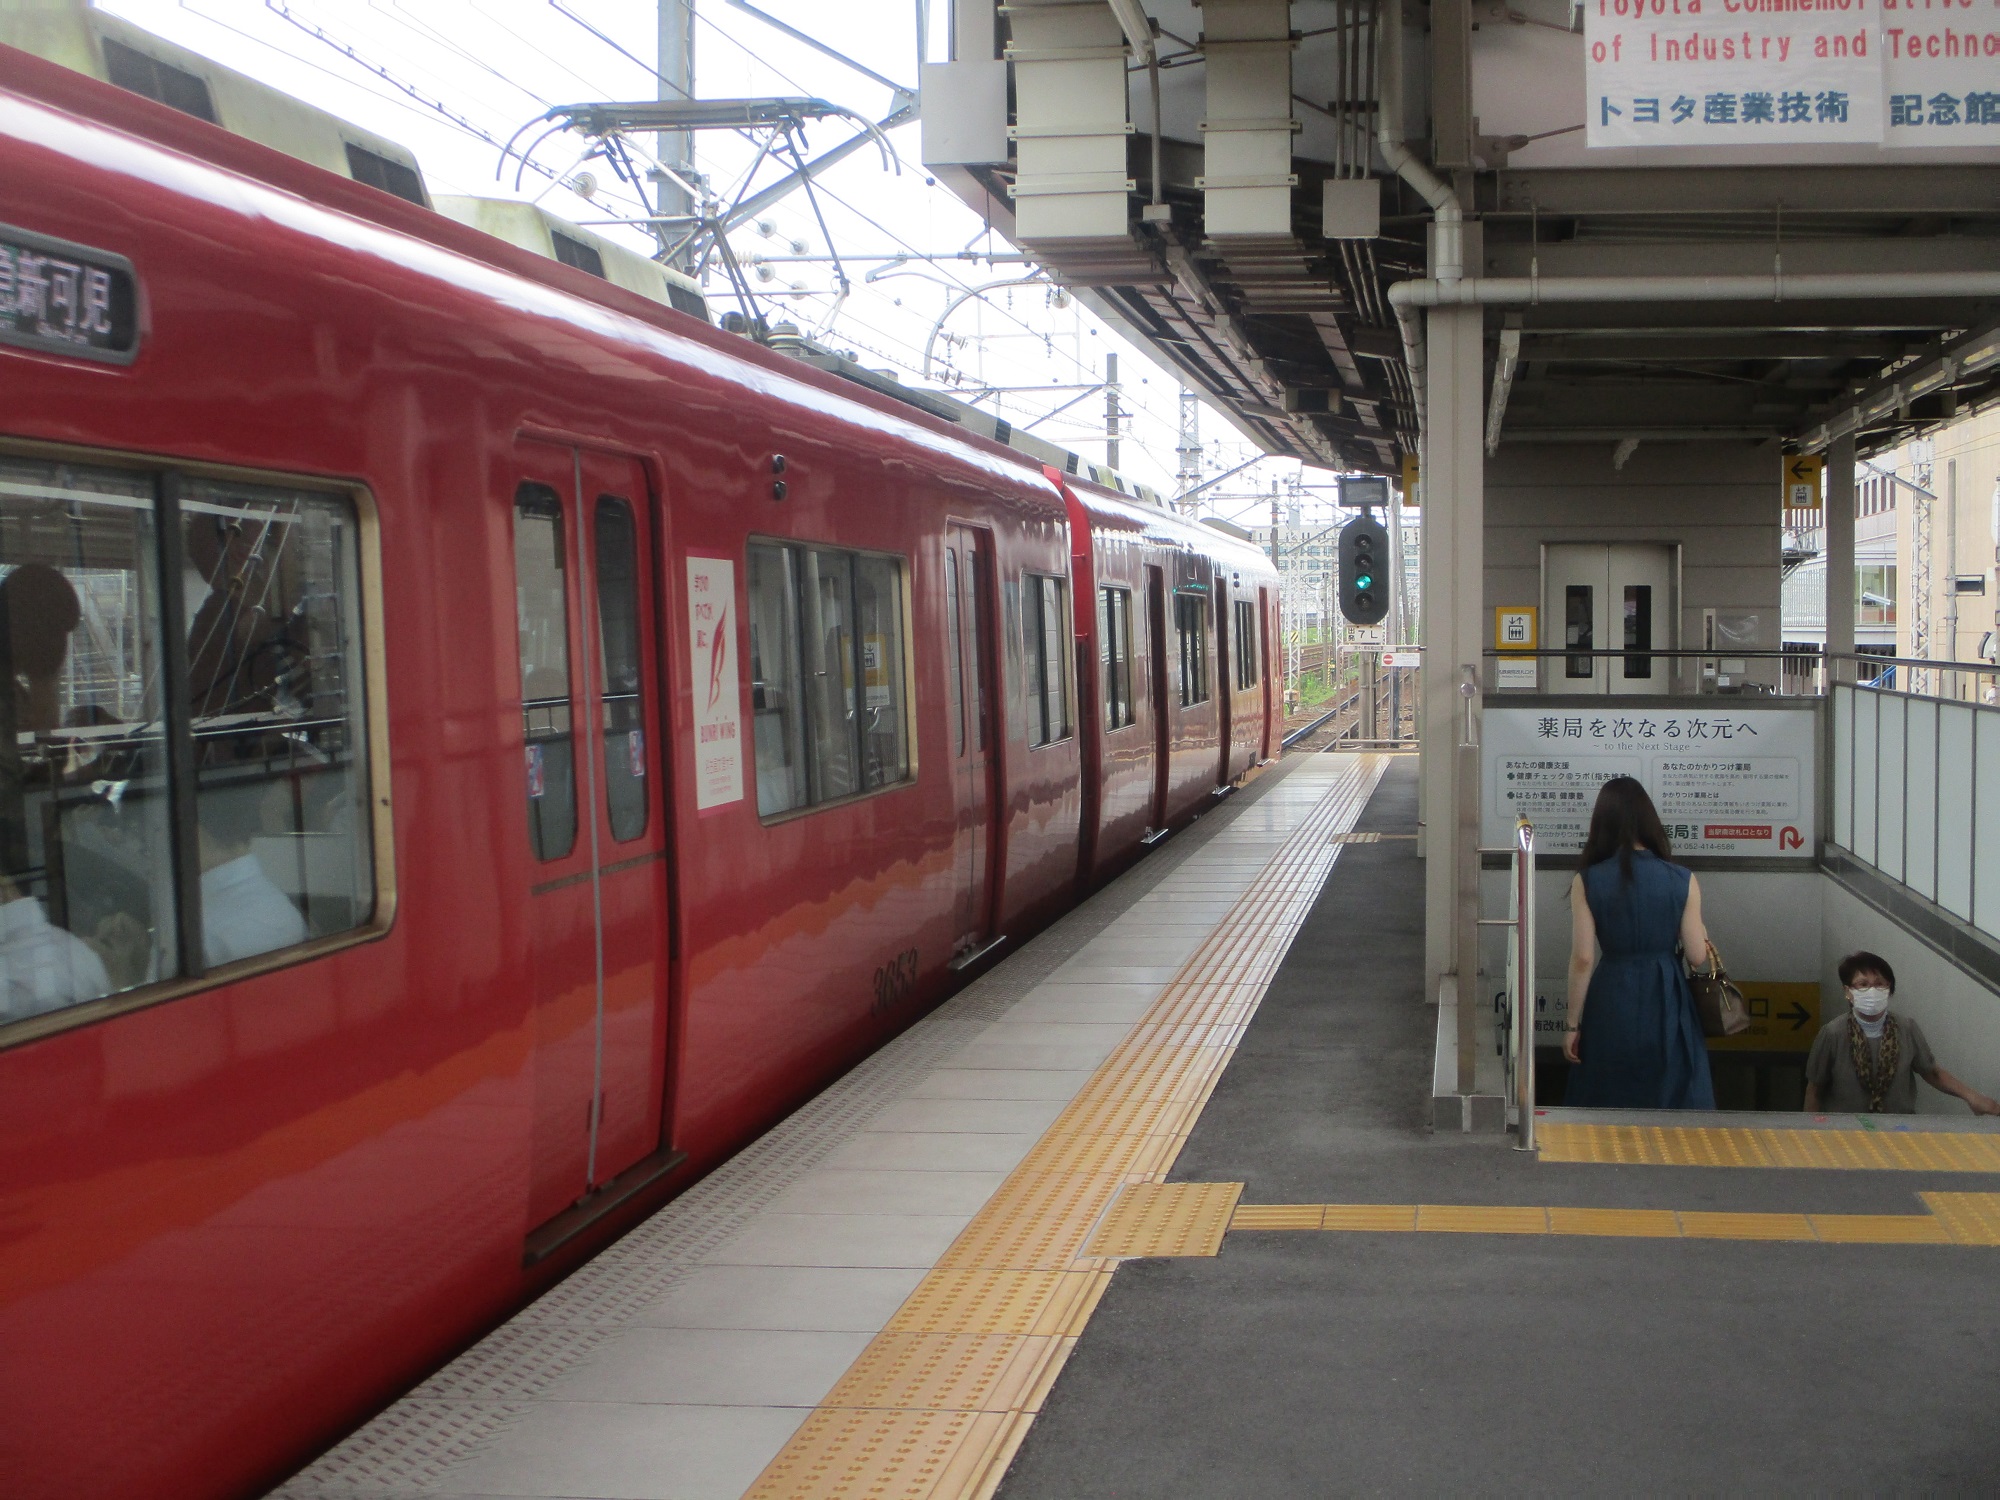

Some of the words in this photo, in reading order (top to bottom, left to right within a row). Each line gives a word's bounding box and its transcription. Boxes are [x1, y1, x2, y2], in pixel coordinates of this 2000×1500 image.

[1591, 34, 1622, 63] of
[1651, 32, 1791, 62] Industry
[1814, 29, 1867, 58] and
[1537, 717, 1758, 739] 薬局を次なる次元へ
[1618, 742, 1633, 750] the
[1663, 742, 1690, 752] Stage
[1506, 762, 1570, 770] あなたの健康支援
[1662, 763, 1752, 771] あなたのかかりつけ薬局
